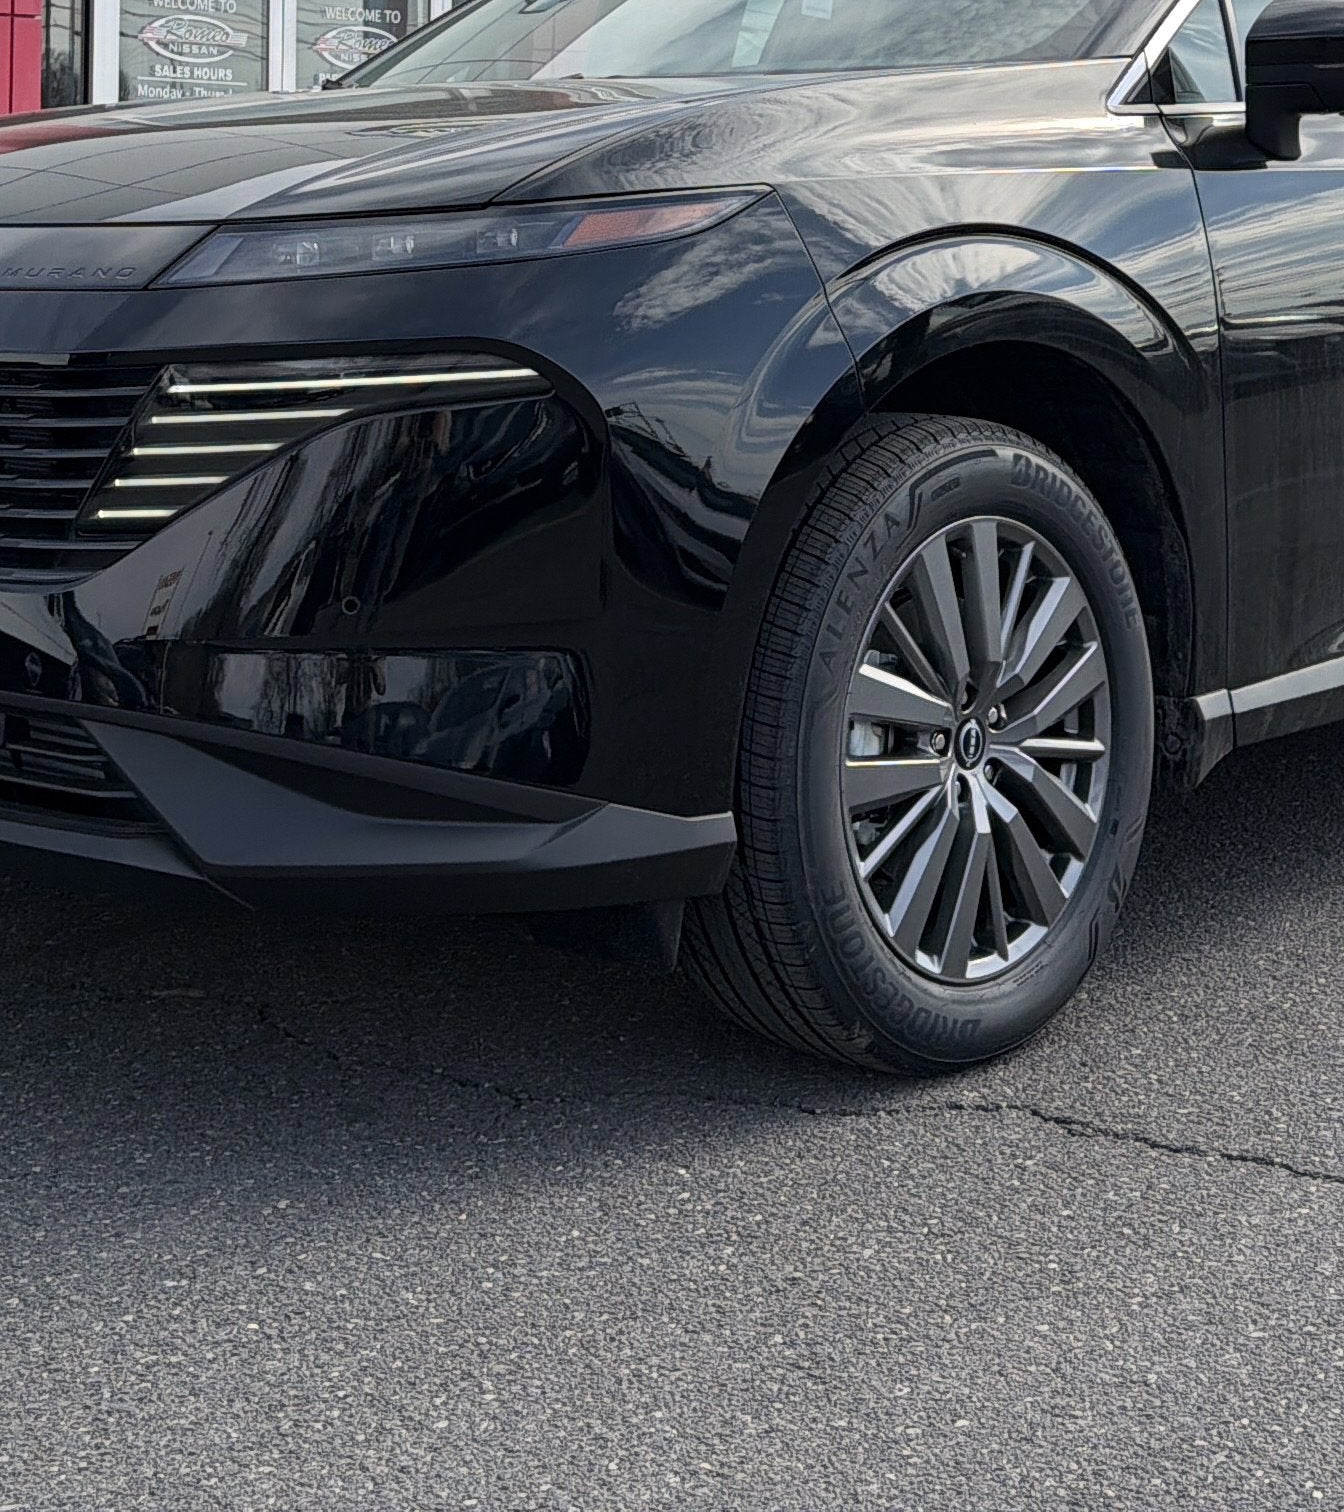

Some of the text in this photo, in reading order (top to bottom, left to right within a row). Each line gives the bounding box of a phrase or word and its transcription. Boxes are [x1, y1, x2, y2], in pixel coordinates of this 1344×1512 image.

[217, 0, 237, 13] TO
[325, 6, 401, 24] WELCOME TO
[159, 17, 231, 43] Romeo
[168, 43, 218, 55] NISSAN
[155, 64, 232, 80] SALES HOURS
[137, 84, 182, 98] Monday
[2, 267, 136, 279] MURANO
[1010, 452, 1138, 630] BRIDGESTONE
[818, 511, 901, 675] ALENZA
